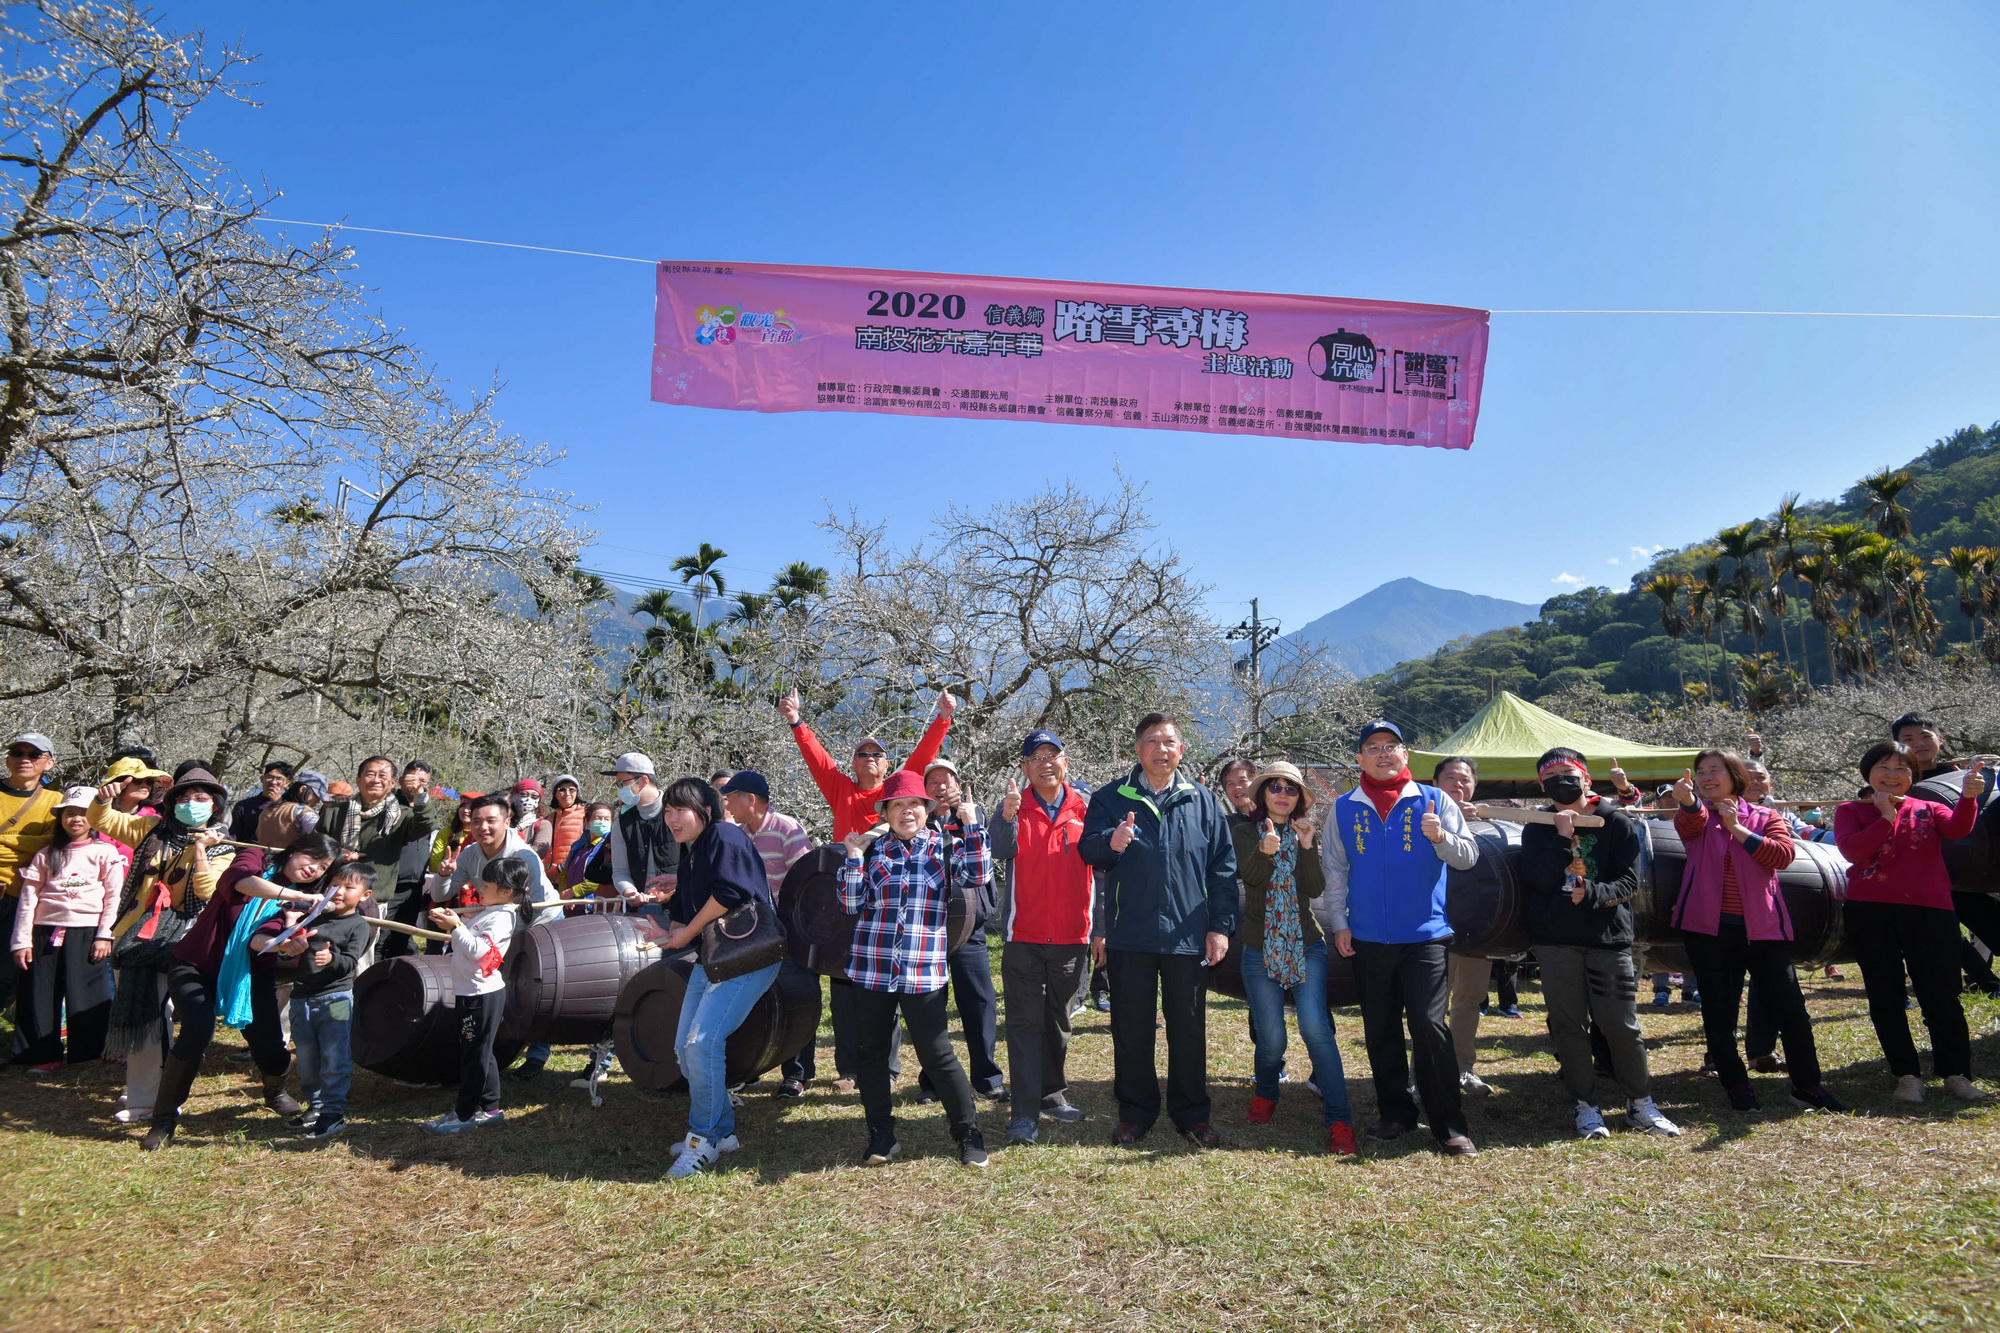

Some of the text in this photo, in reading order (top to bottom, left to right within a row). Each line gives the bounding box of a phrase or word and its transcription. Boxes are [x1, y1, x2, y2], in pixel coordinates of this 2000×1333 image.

[866, 290, 1045, 327] 2020 信義鄉
[740, 312, 775, 328] 觀光
[1053, 300, 1249, 351] 踏雪尋梅
[761, 328, 795, 344] 首都
[855, 325, 1045, 358] 南投花卉嘉年華
[1331, 343, 1374, 363] 同心
[1403, 352, 1448, 374] 甜蜜
[1202, 353, 1294, 379] 主題活動
[1403, 371, 1447, 390] 負擔
